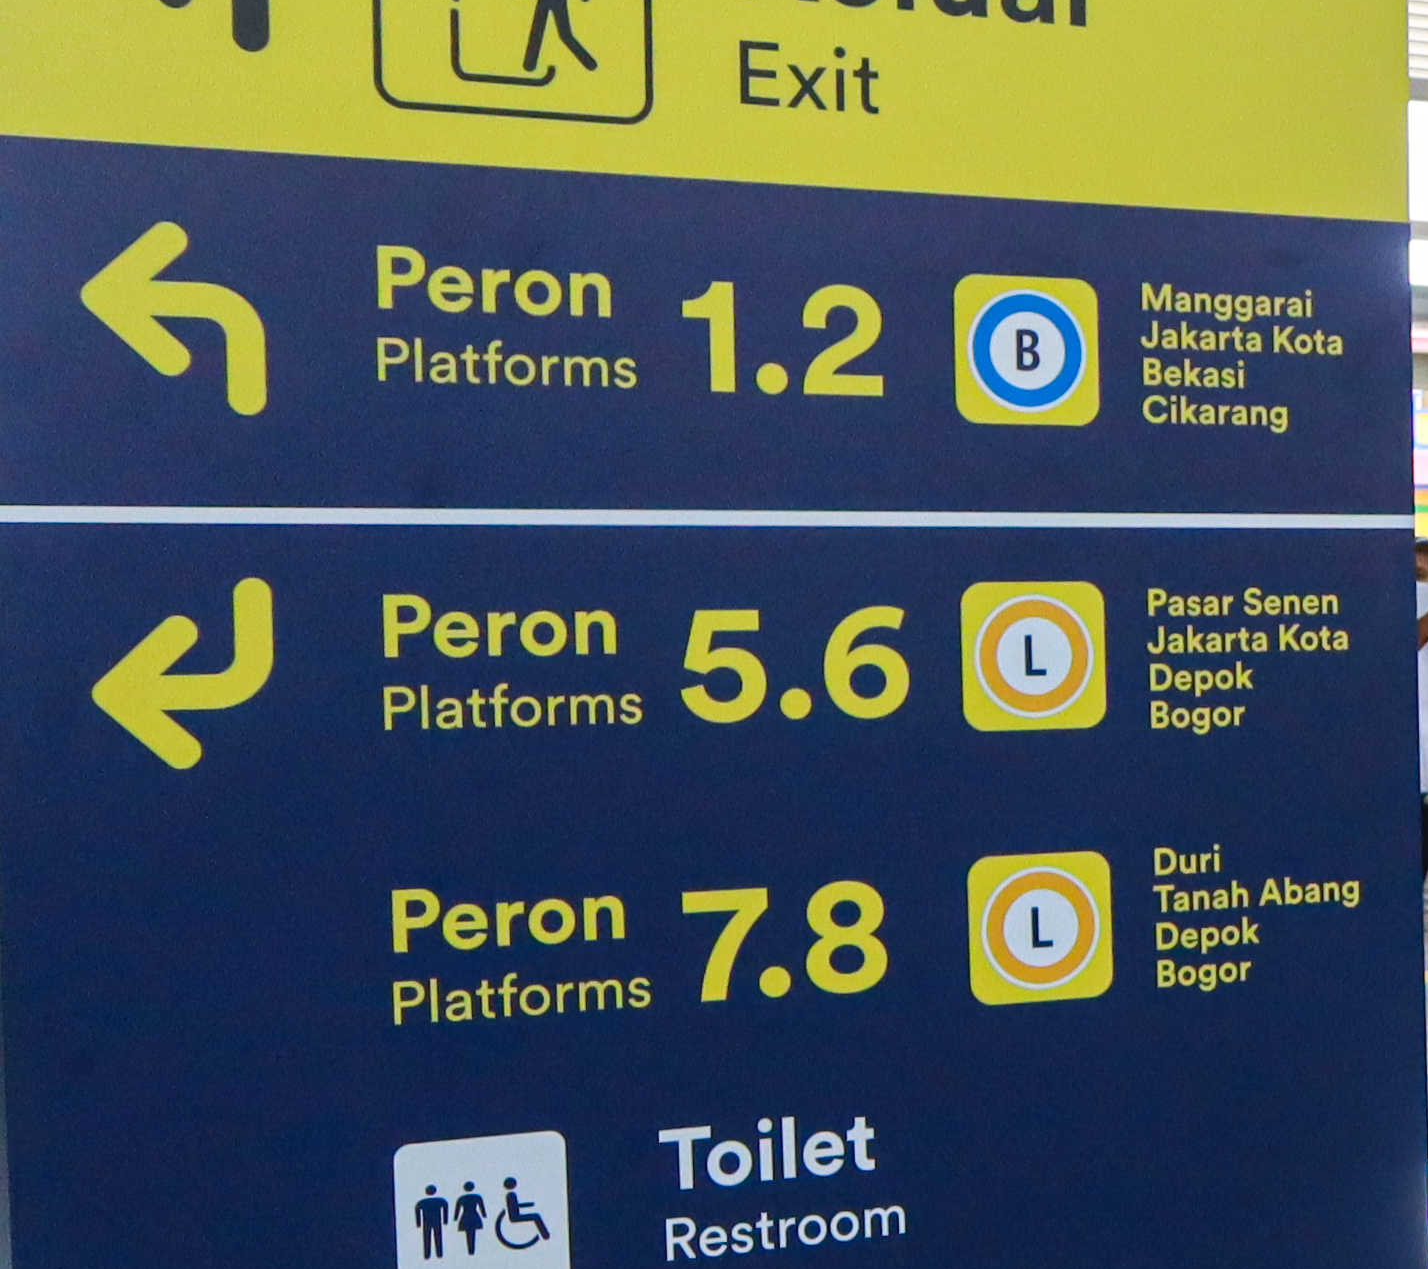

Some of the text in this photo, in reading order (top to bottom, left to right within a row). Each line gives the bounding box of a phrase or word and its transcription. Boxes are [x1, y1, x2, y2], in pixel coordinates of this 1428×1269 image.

[740, 40, 879, 114] Exit
[377, 245, 611, 317] Peron
[1142, 283, 1312, 322] Manggarai
[1016, 329, 1040, 371] B
[1141, 321, 1343, 355] Jakarta Kota
[377, 338, 637, 388] Platforms
[1143, 358, 1244, 388] Bekasi
[1143, 395, 1288, 433] Cikarang
[1148, 588, 1338, 616] Pasar Senen
[383, 594, 616, 658] Peron
[1147, 624, 1348, 654] Jakarta Kota
[1025, 635, 1046, 676] L
[1150, 661, 1253, 697] Depok
[384, 683, 642, 730] Platforms
[1151, 701, 1245, 735] Bogor
[1154, 848, 1220, 875] Duri
[1153, 877, 1359, 912] Tanah Abang
[392, 889, 625, 952] Peron
[1031, 907, 1053, 948] L
[1156, 917, 1259, 954] Depok
[1157, 960, 1251, 991] Bogor
[393, 973, 651, 1025] Platforms
[659, 1117, 875, 1189] Toilet
[666, 1206, 905, 1261] Restroom
